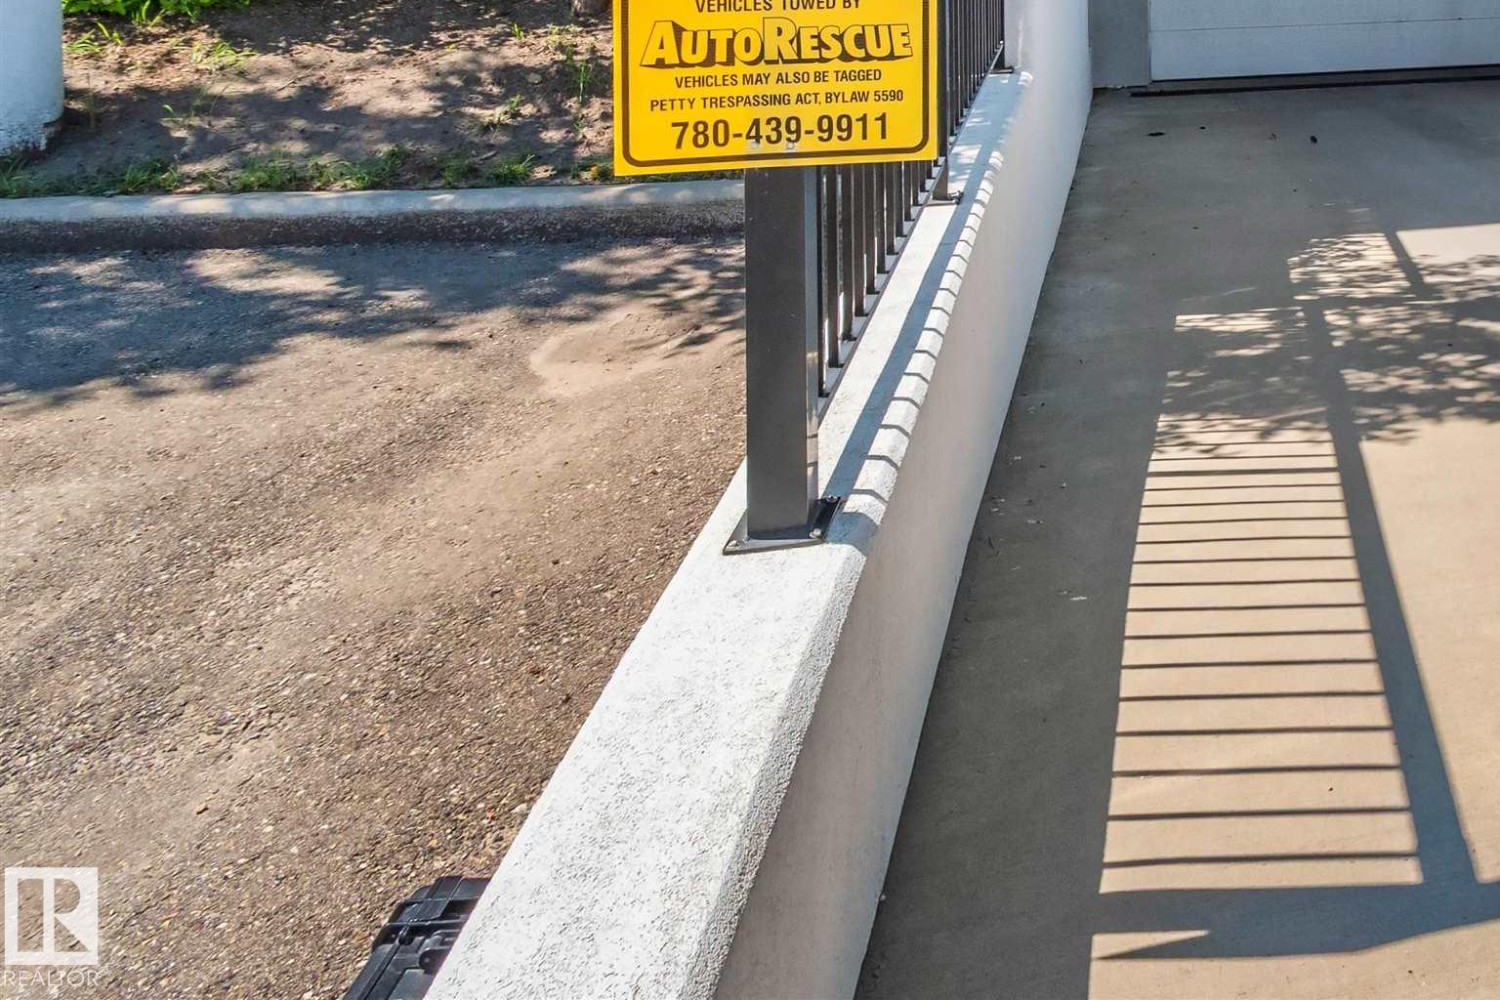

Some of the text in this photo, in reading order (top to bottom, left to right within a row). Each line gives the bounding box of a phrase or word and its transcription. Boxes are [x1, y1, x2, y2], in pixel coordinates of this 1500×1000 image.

[675, 68, 882, 89] VEHICLES MAY ALSO BE TAGGED
[650, 89, 904, 112] PETTY TRESPASSING ACT, BYLAW 5590
[671, 112, 888, 150] 780-439-9911
